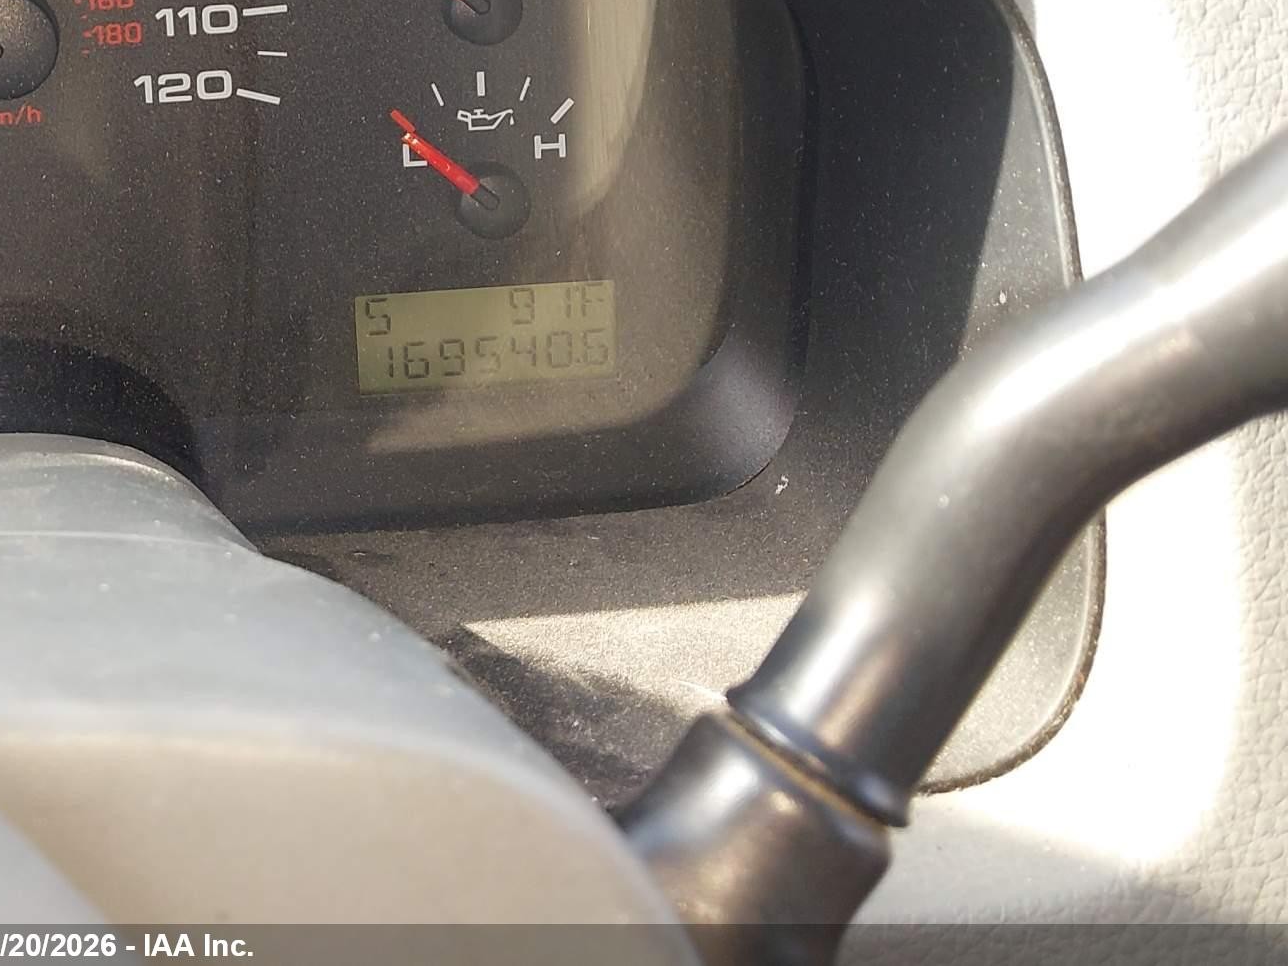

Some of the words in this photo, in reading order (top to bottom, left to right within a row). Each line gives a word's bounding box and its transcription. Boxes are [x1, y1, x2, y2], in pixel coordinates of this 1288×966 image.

[91, 22, 143, 44] 180
[154, 4, 238, 38] 110
[133, 70, 232, 104] 120
[402, 143, 428, 167] L
[534, 134, 566, 159] H
